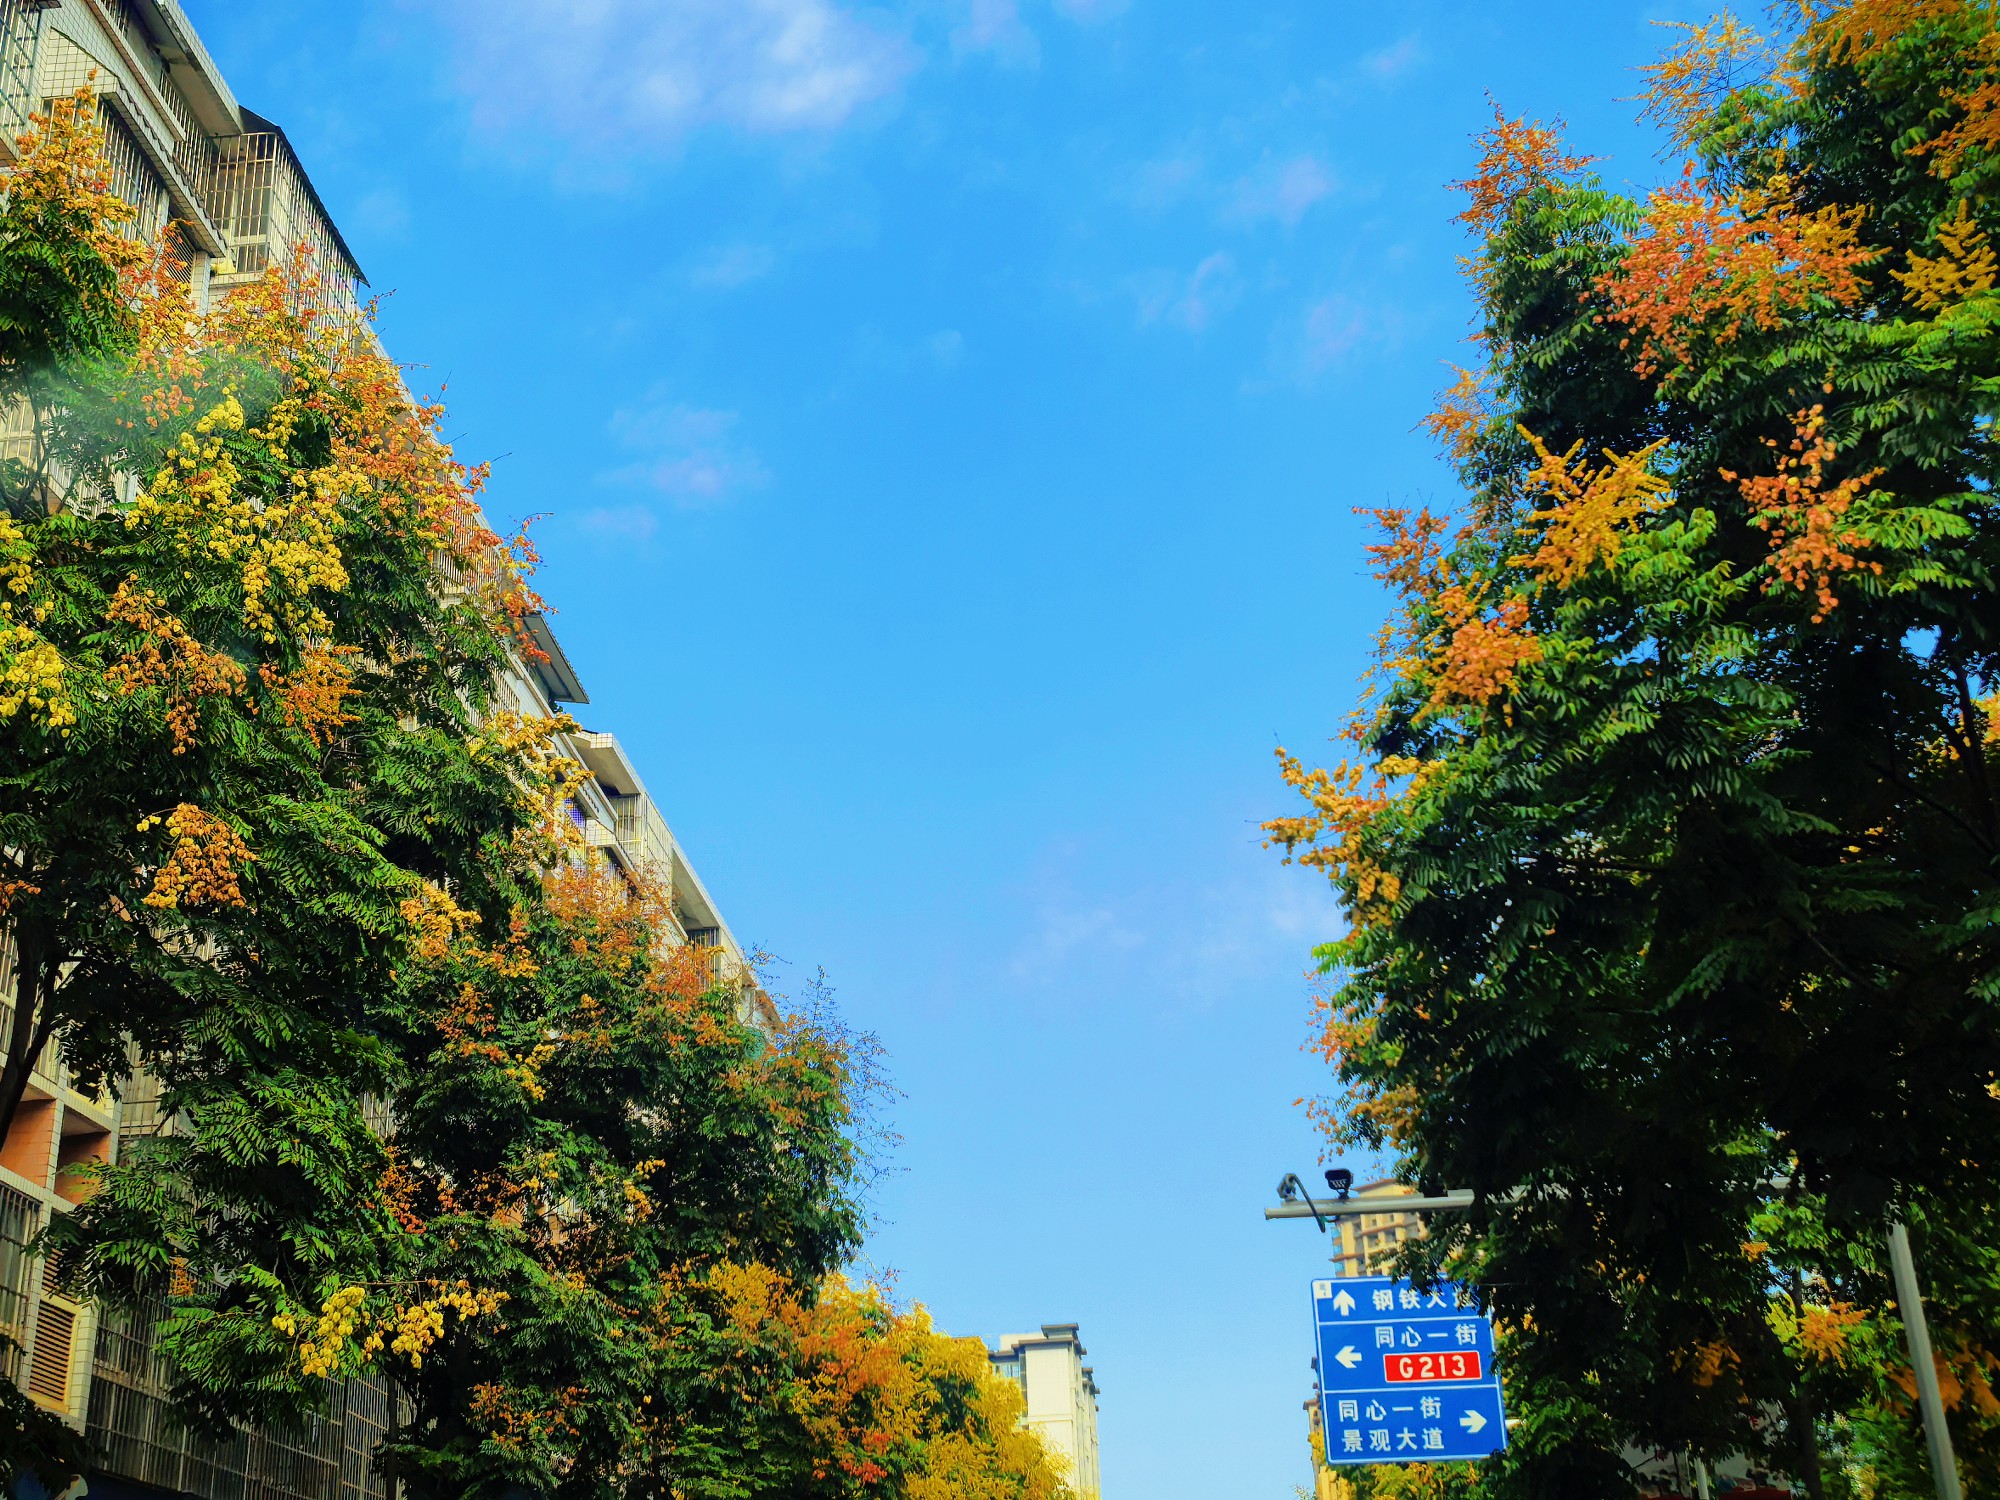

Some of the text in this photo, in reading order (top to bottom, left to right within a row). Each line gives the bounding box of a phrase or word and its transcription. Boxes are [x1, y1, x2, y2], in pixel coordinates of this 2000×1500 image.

[1374, 1323, 1478, 1349] 同心一街
[1399, 1354, 1467, 1379] G213
[1338, 1396, 1442, 1423] 同心一街
[1341, 1427, 1445, 1453] 景观大道
